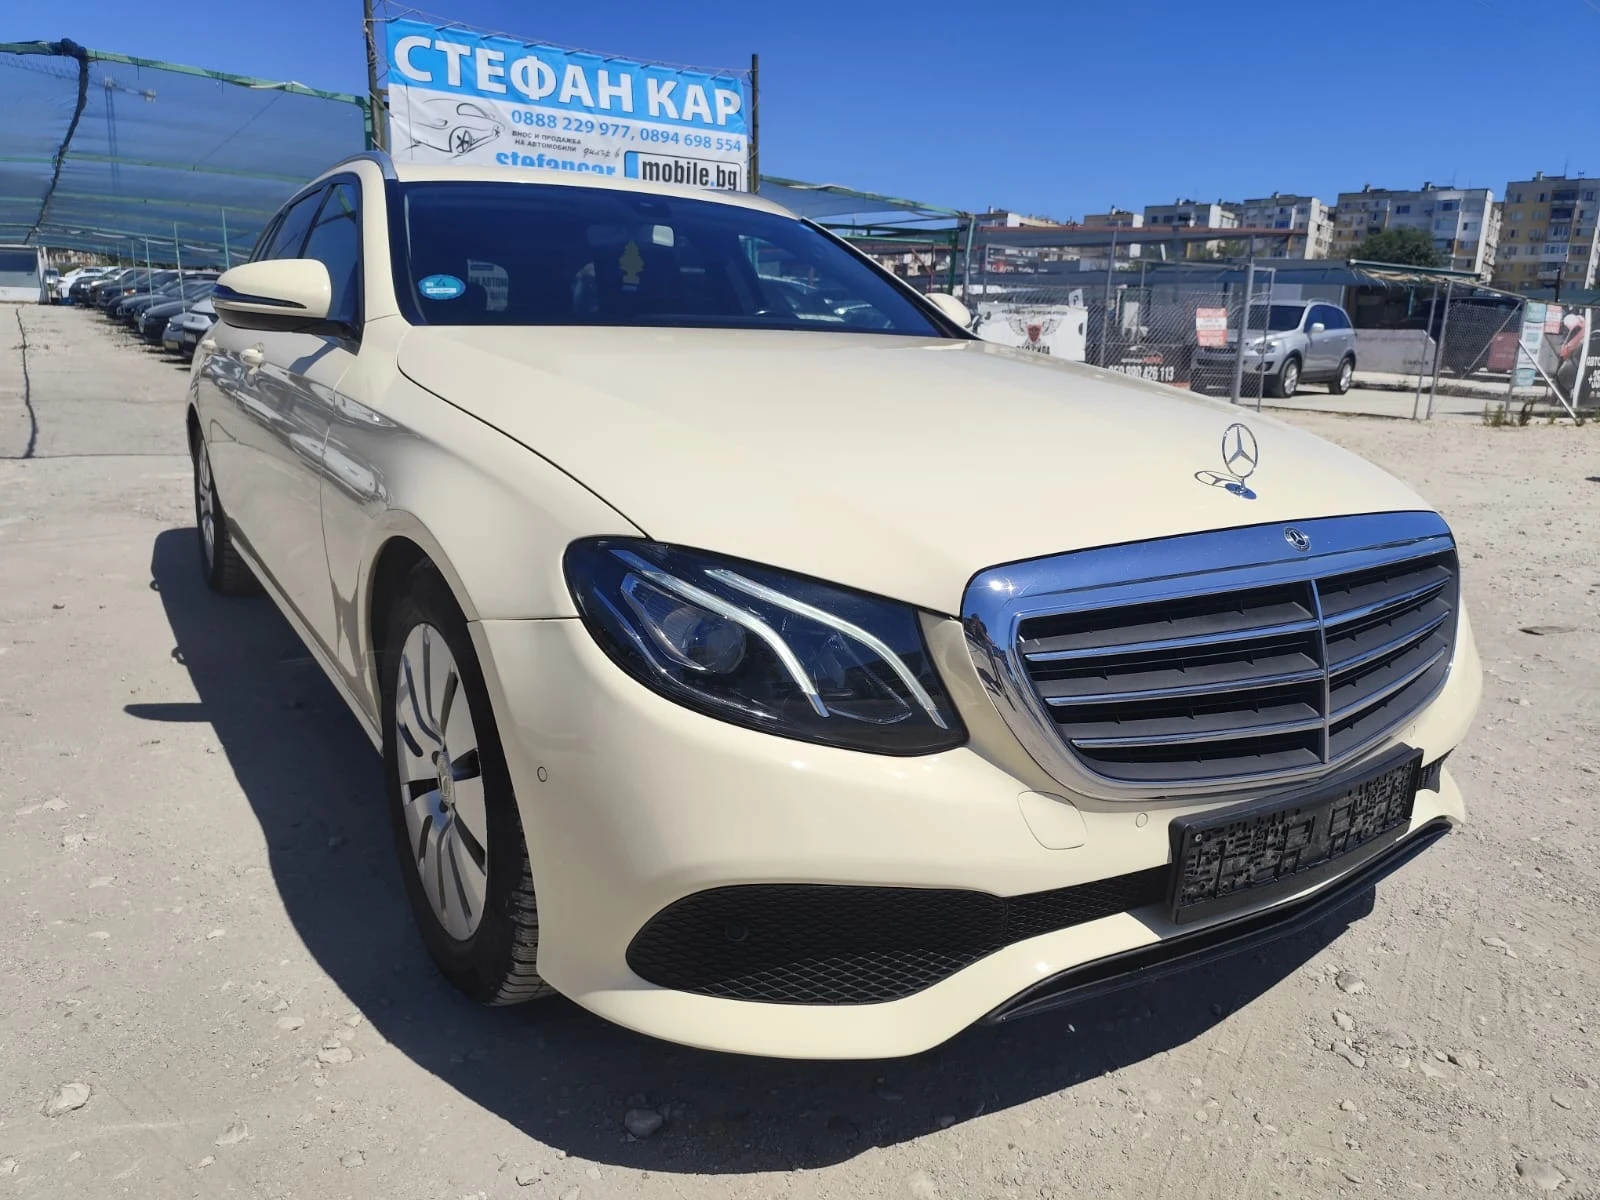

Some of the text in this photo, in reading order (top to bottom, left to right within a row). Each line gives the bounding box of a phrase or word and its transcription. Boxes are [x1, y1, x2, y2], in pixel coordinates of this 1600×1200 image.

[394, 35, 742, 126] СТЕФАН КАР
[511, 110, 741, 152] 0888 229 977, 0894 698 554
[512, 130, 533, 139] ВНОС
[541, 134, 582, 145] ПРОДАЖБА
[527, 141, 577, 153] АВТОМОБИЛИ
[642, 160, 738, 191] mobile.bg
[1160, 366, 1174, 381] 113
